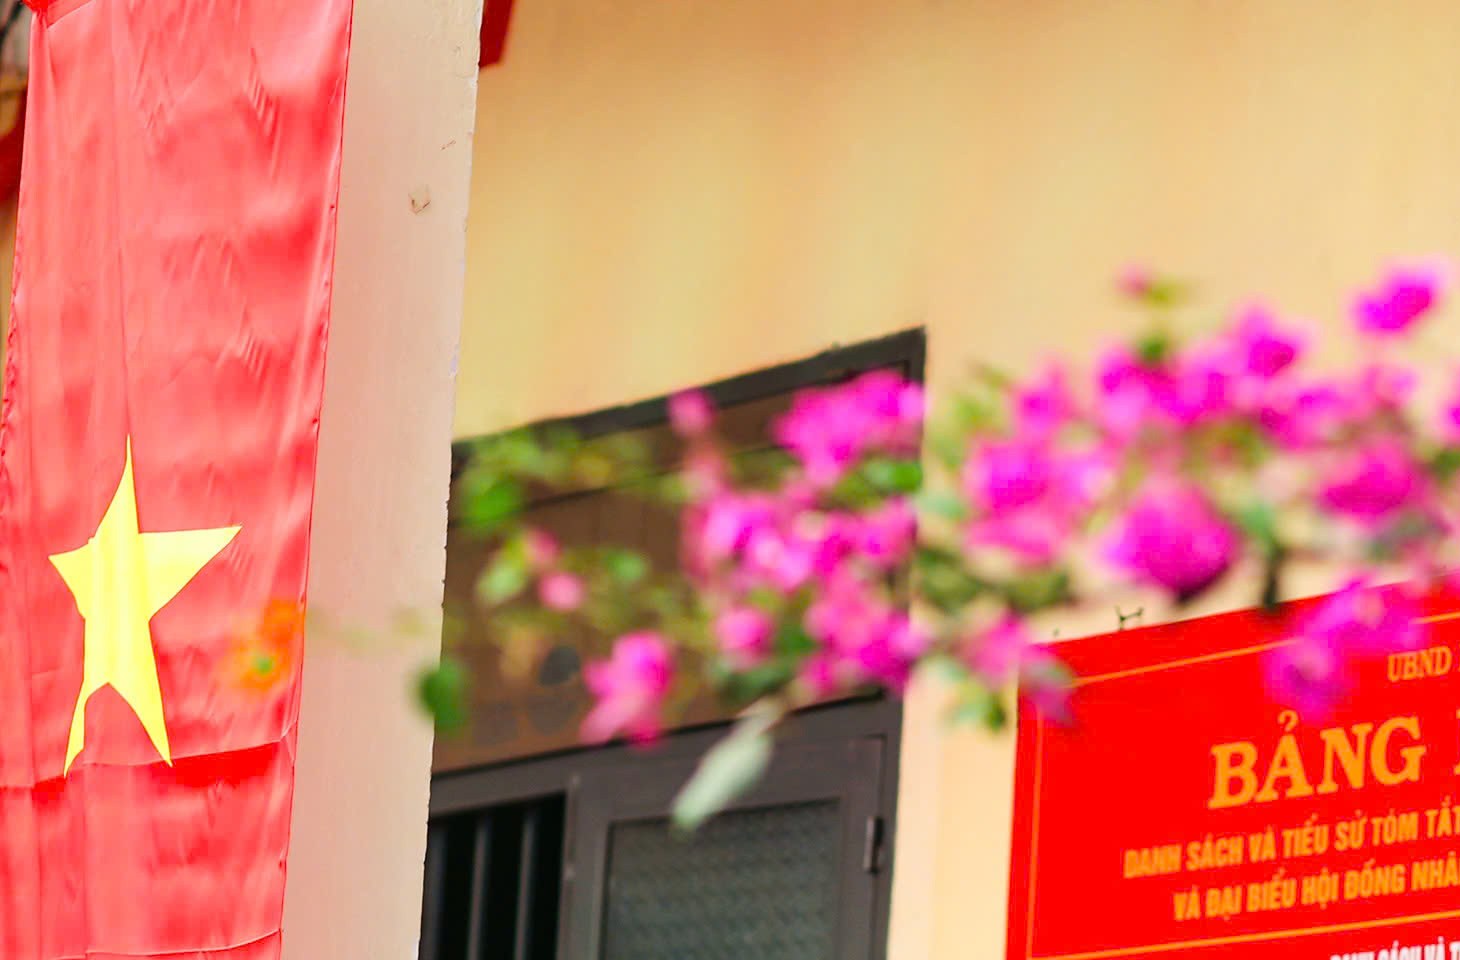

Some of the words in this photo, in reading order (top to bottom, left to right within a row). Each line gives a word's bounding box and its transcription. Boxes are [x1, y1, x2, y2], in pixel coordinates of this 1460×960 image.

[1388, 645, 1451, 682] UBND
[1208, 709, 1427, 809] BẢNG
[1123, 844, 1182, 879] DANH
[1186, 833, 1244, 871] SÁCH
[1250, 824, 1276, 863] VÀ
[1282, 812, 1329, 858] TIỂU
[1335, 810, 1366, 851] SỬ
[1371, 808, 1419, 846] TÓM
[1173, 884, 1200, 921] VÀ
[1206, 886, 1241, 922] ĐẠI
[1247, 867, 1297, 912] BIỂU
[1302, 867, 1339, 910] HỘI
[1344, 858, 1406, 899] ĐỒNG
